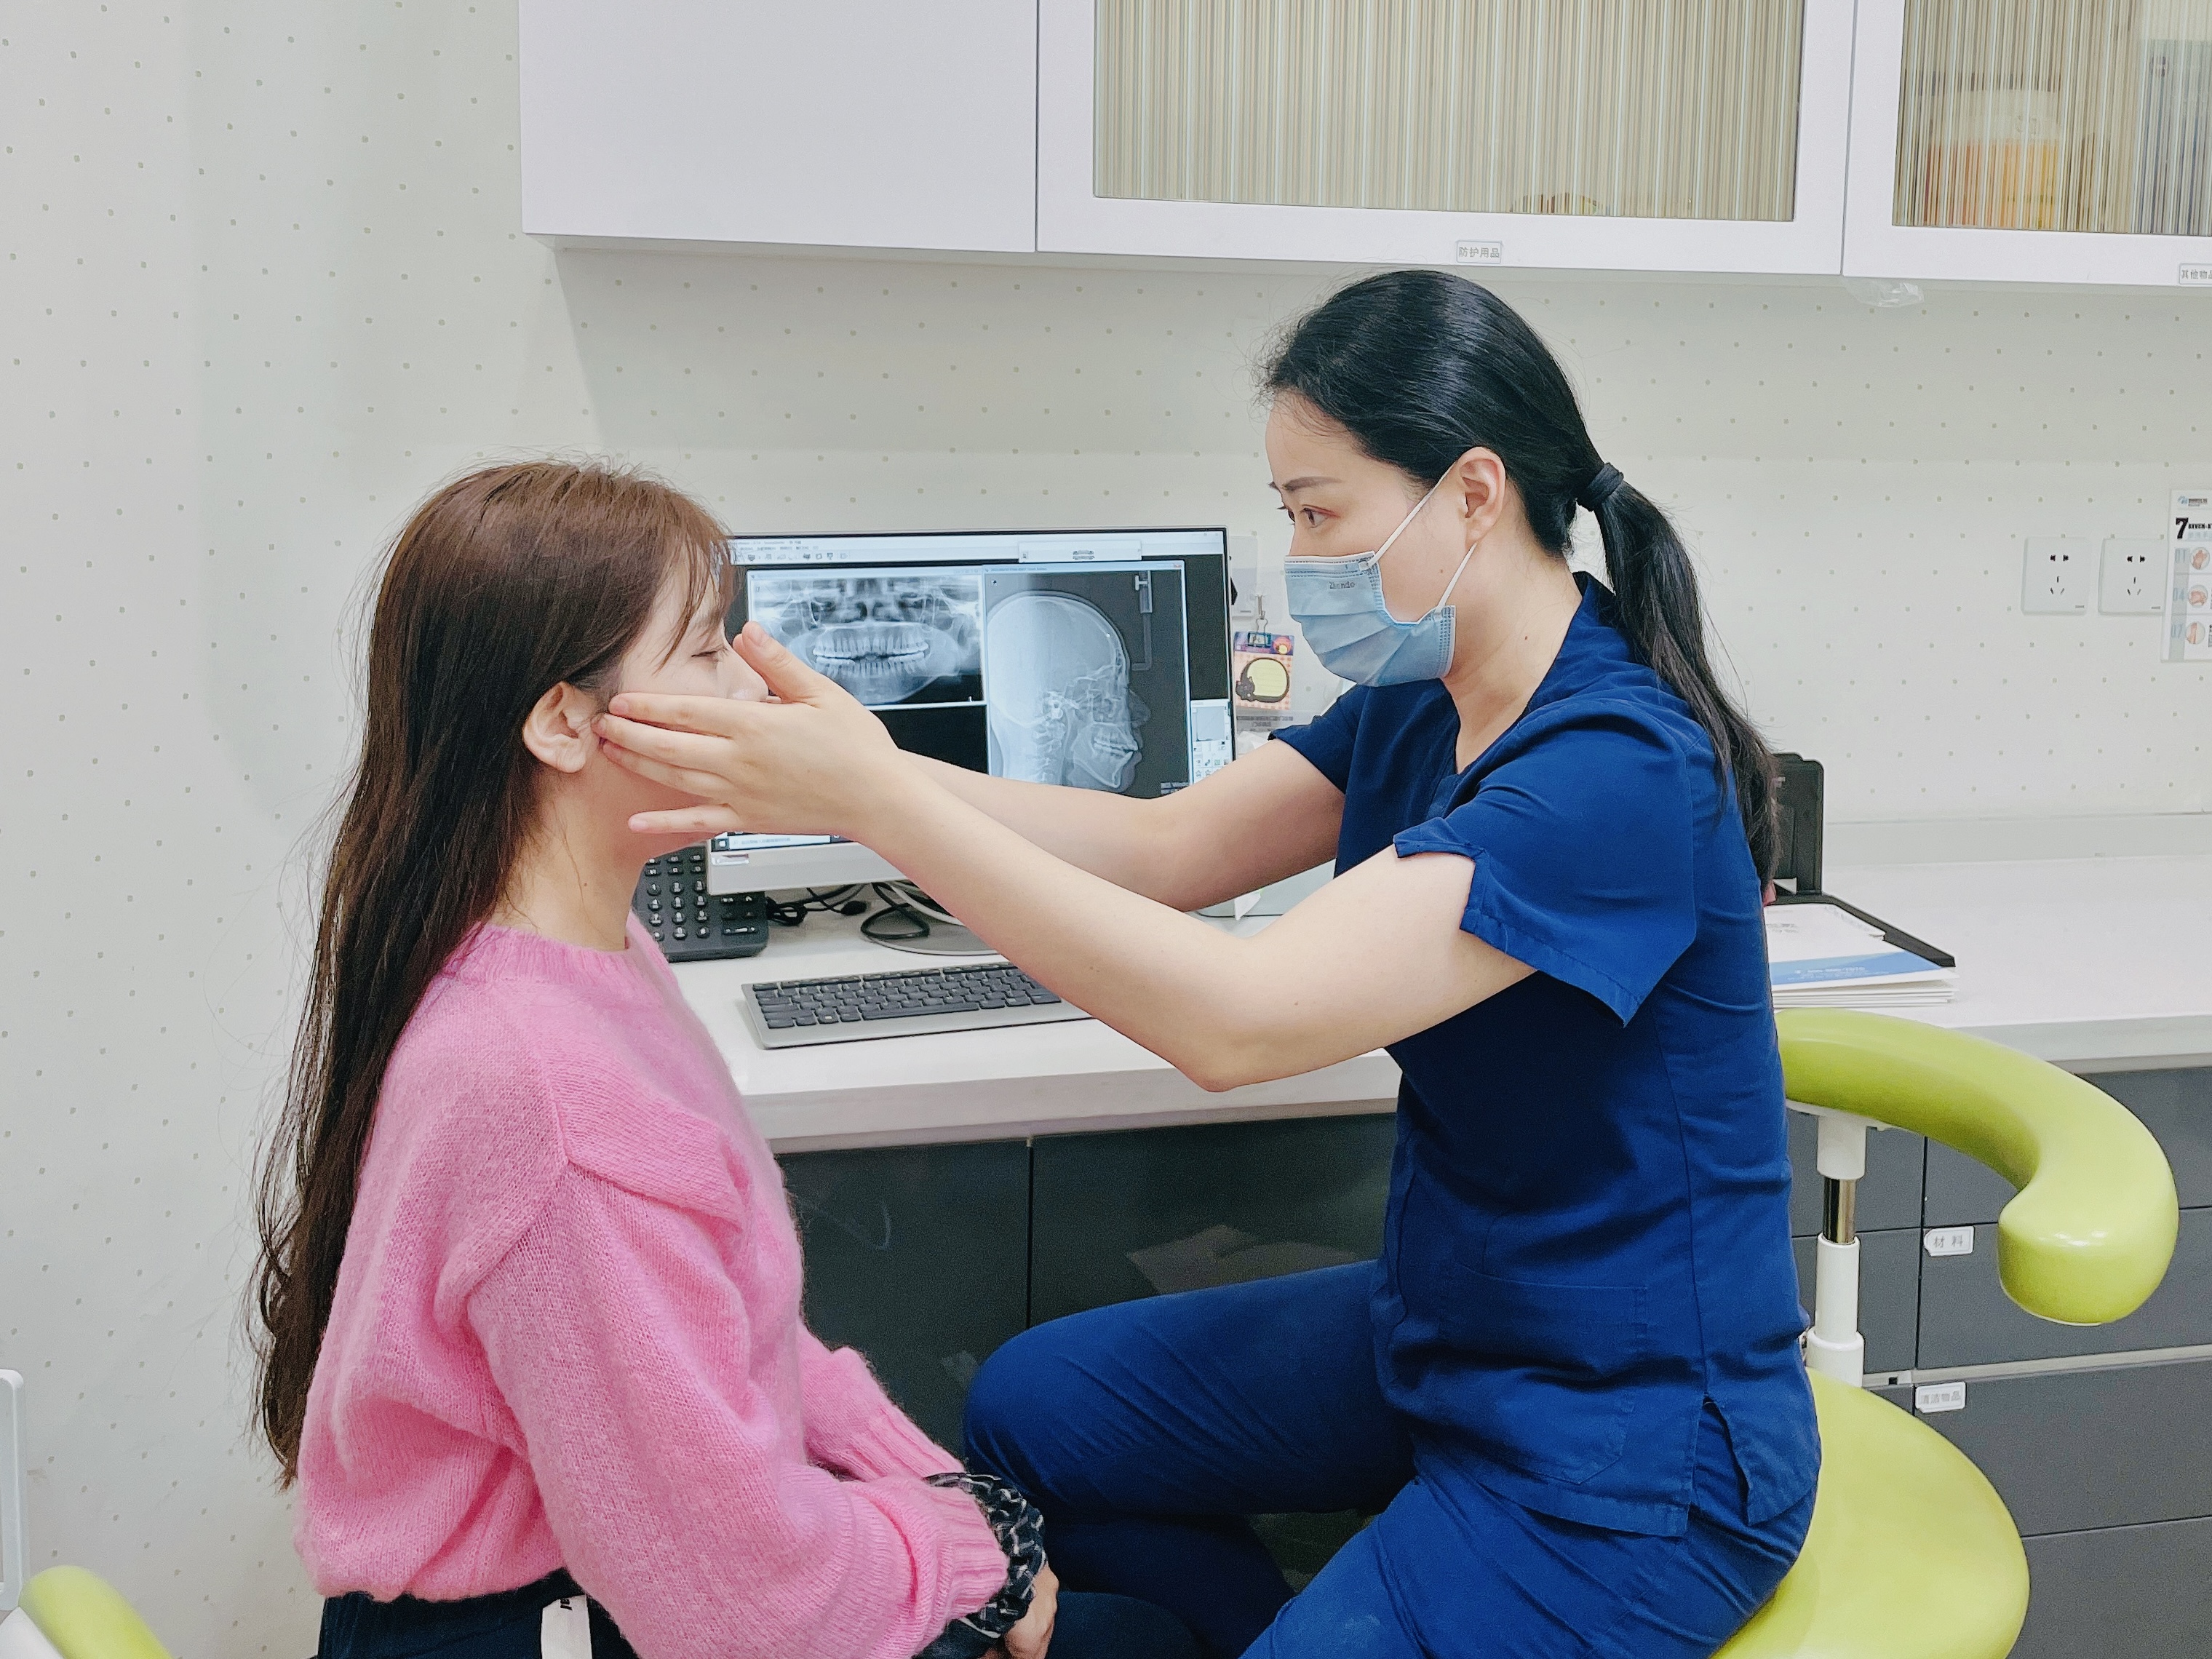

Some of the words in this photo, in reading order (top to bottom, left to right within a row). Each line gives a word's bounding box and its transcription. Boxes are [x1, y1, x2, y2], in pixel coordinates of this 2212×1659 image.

[1458, 247, 1500, 258] 防护用品
[2176, 517, 2189, 539] 7
